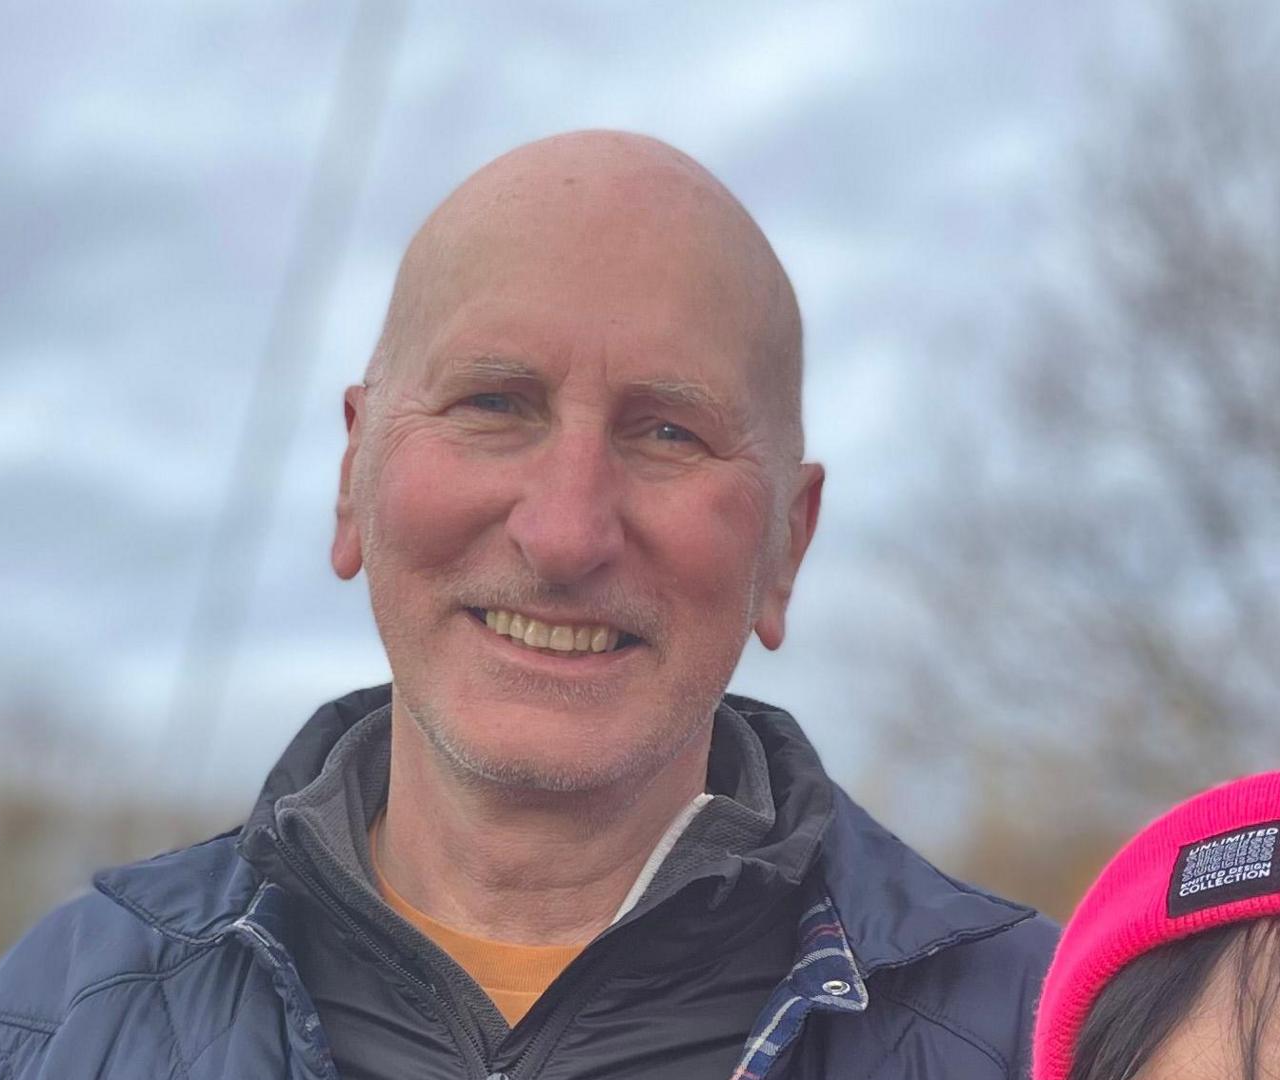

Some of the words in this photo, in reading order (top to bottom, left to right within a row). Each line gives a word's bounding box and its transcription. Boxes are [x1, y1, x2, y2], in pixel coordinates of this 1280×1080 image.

[1189, 827, 1279, 856] UNLIMITED
[1179, 868, 1271, 897] COLLECTION
[1180, 869, 1226, 889] KNITTED
[1229, 860, 1272, 875] DESIGN
